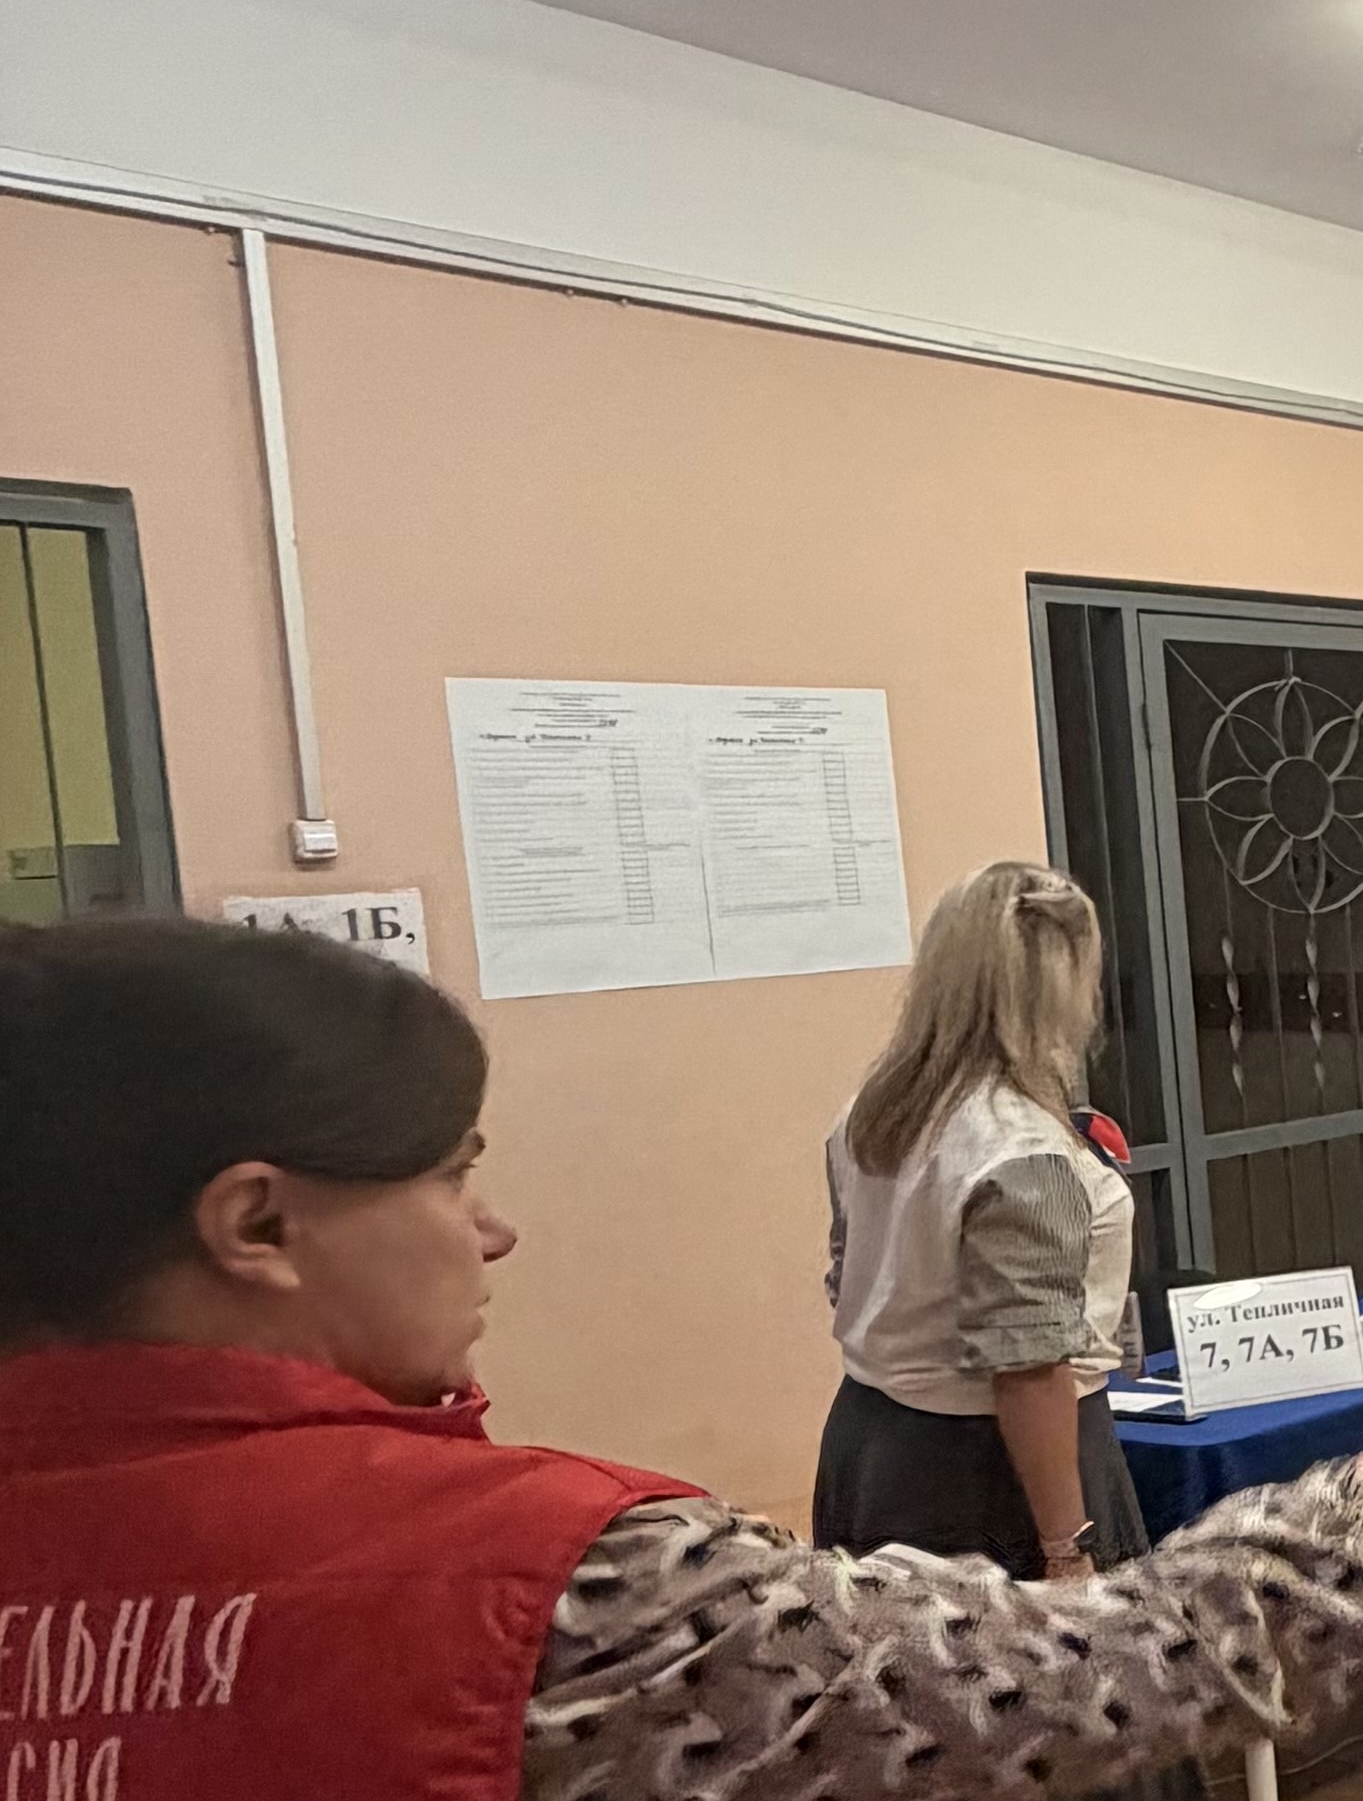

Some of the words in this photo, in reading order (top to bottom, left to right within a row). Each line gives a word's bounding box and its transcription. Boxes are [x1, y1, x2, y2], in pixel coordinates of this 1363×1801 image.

[341, 906, 417, 944] 1Б,
[1187, 1310, 1221, 1334] ул.
[1224, 1295, 1345, 1323] Тепличная
[1200, 1341, 1231, 1372] 7,
[1237, 1332, 1296, 1363] 7А,
[1302, 1323, 1345, 1354] 7Б
